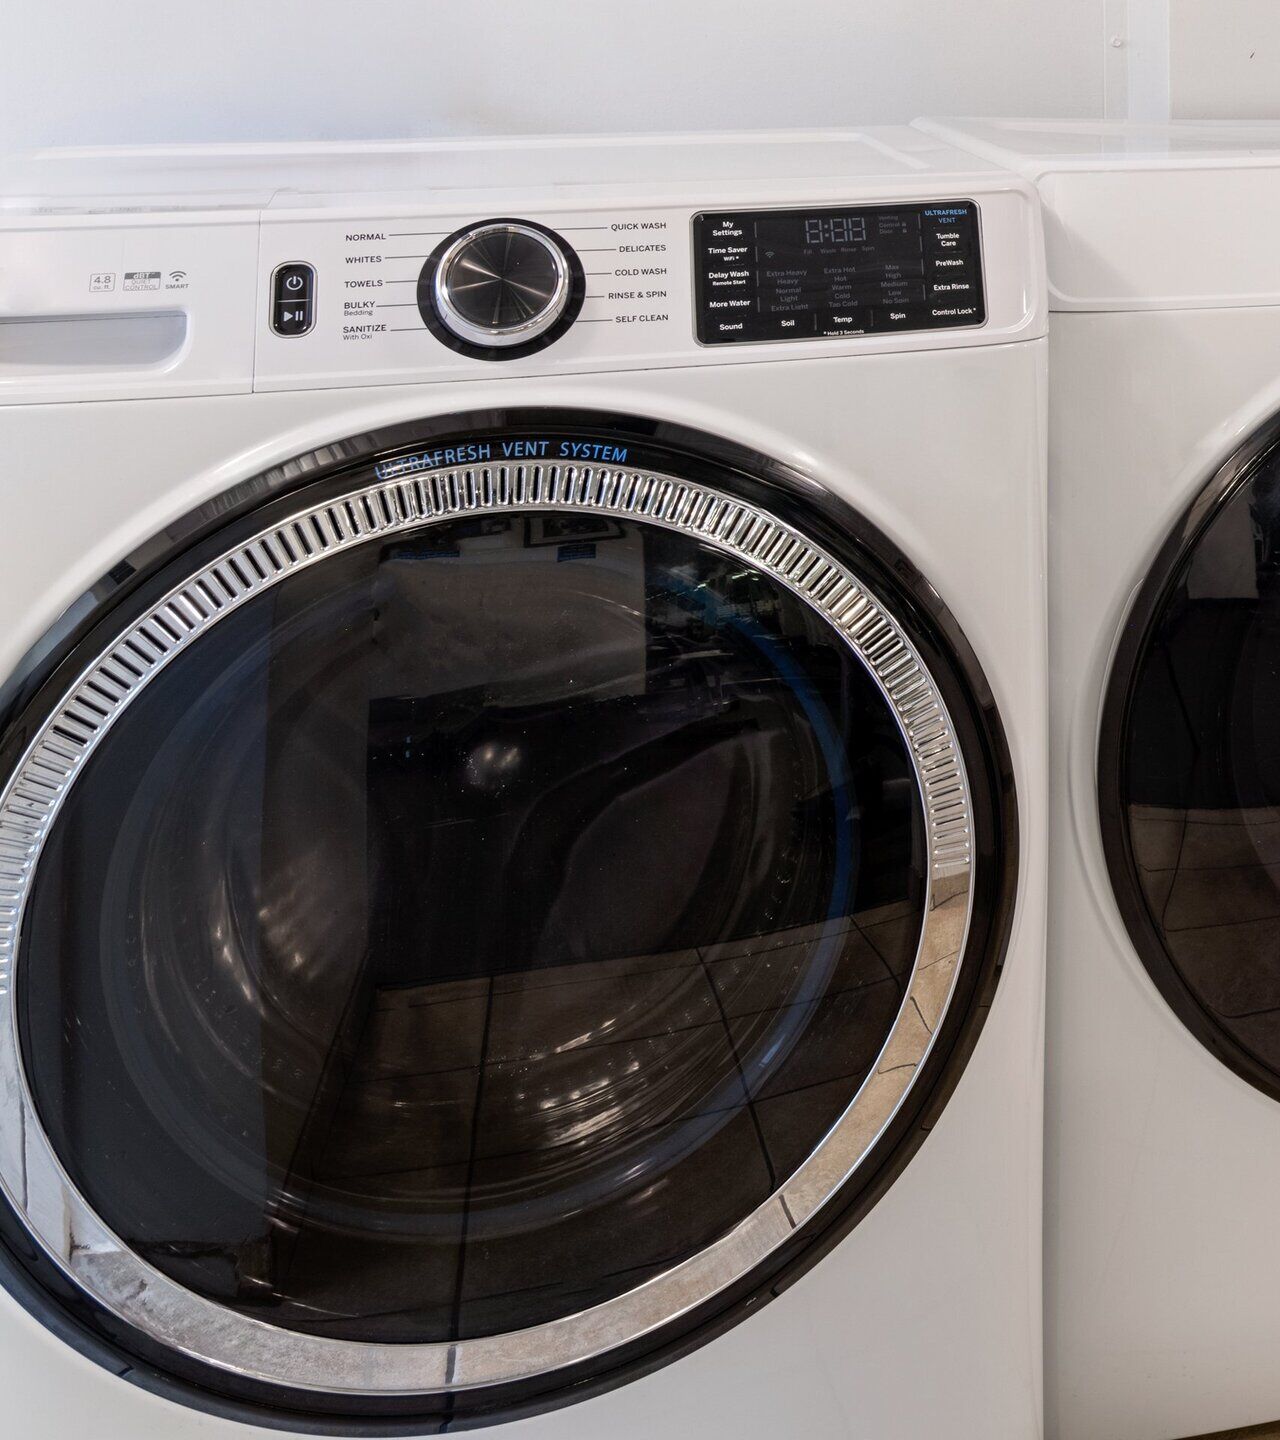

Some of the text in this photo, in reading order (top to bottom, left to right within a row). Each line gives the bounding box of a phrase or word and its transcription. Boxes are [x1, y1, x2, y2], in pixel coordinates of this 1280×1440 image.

[611, 223, 639, 231] QUICK
[345, 233, 387, 241] NORMAL
[345, 256, 382, 264] WHITES
[94, 276, 111, 284] 4.8
[344, 280, 383, 288] TOWELS
[344, 301, 375, 309] BULKY
[343, 325, 387, 333] SANITIZE
[374, 441, 627, 480] ULTRAFRESH VENT SYSTEM
